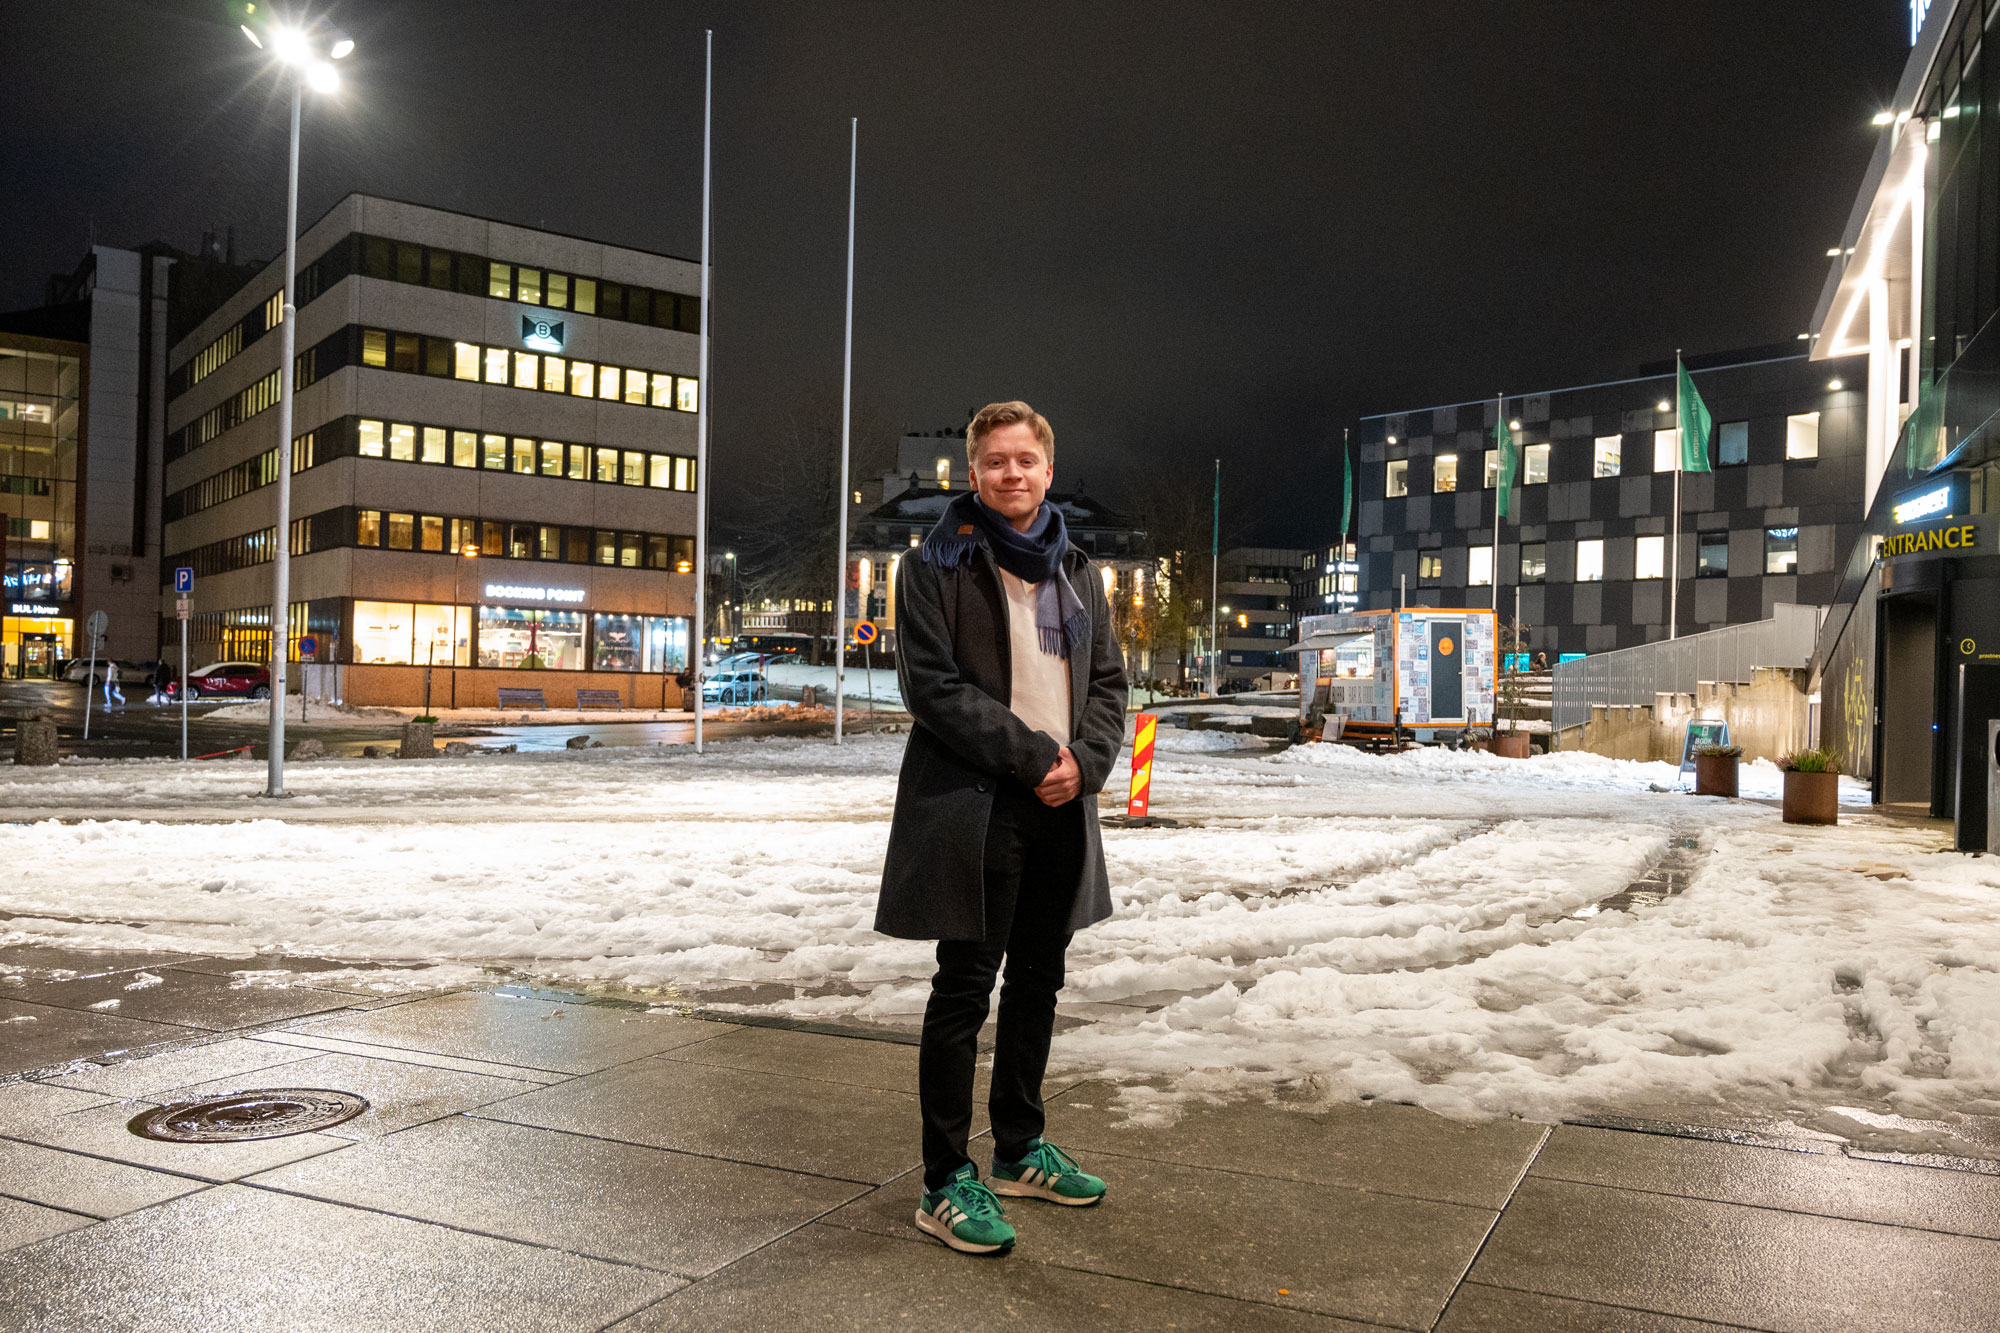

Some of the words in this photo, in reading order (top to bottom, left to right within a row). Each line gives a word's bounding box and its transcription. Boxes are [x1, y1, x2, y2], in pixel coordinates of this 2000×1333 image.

[539, 324, 548, 336] B
[1883, 525, 1975, 557] ENTRANCE
[179, 570, 189, 590] P
[486, 584, 545, 600] BOOKING
[547, 588, 585, 602] POINT
